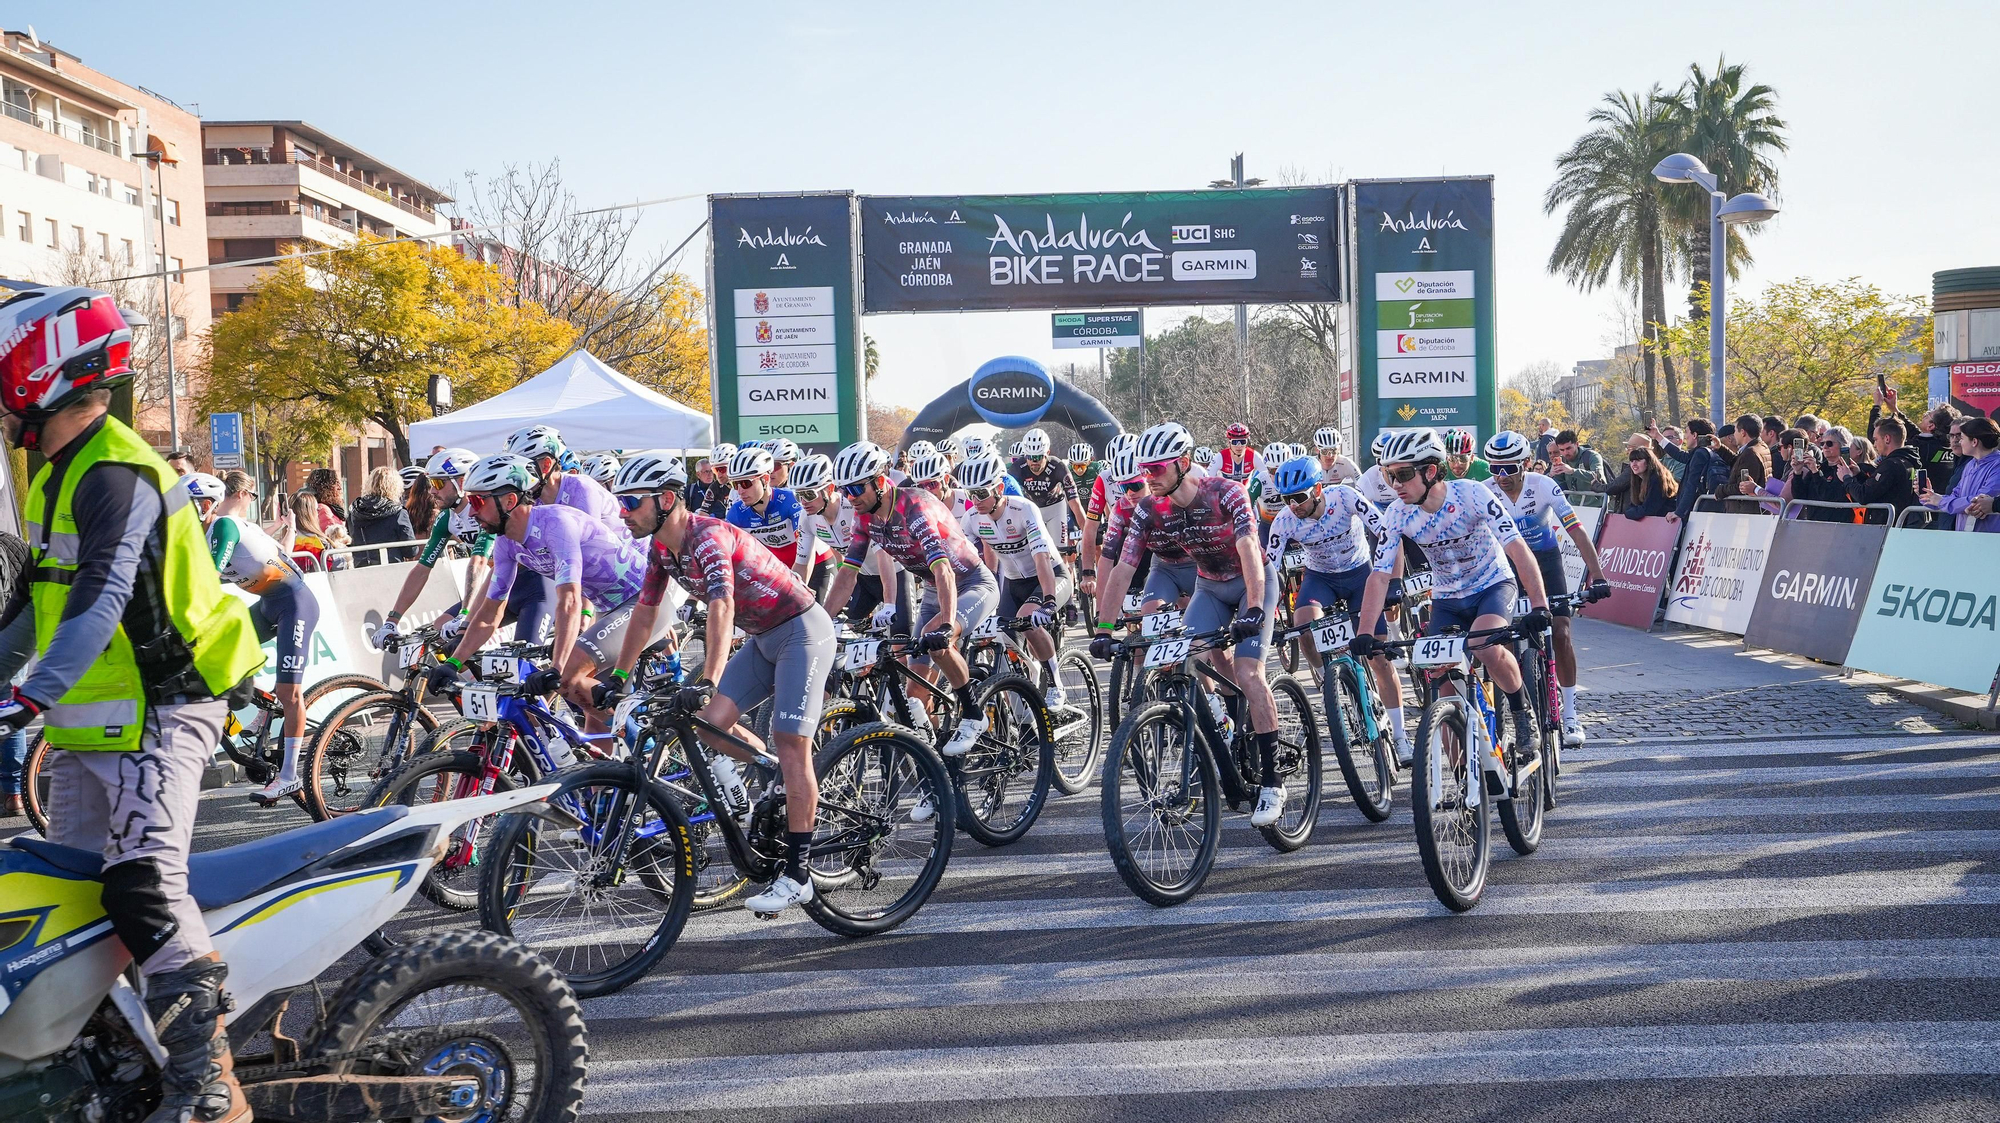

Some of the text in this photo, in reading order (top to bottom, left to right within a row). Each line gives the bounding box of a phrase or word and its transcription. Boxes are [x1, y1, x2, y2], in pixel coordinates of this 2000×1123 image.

[884, 211, 938, 225] Andalucía
[1379, 209, 1469, 233] Andalucía
[737, 225, 828, 249] Andalucía
[985, 210, 1163, 256] Andalucía
[1178, 228, 1236, 240] UCI SHC
[899, 241, 953, 254] GRANADA
[911, 255, 941, 271] JAÉN
[989, 253, 1165, 286] BIKE RACE
[1181, 259, 1248, 271] GARMIN
[900, 271, 953, 287] CÓRDOBA
[1417, 280, 1454, 289] Diputación
[1073, 326, 1119, 336] CÓRDOBA
[1418, 336, 1455, 345] Diputación
[1428, 343, 1456, 351] Córdoba
[778, 352, 818, 360] AYUNTAMIENTO
[1982, 346, 2000, 356] AYU
[778, 361, 785, 369] DE
[1388, 370, 1466, 385] GARMIN
[748, 387, 829, 402] GARMIN
[977, 386, 1046, 399] GARMIN
[912, 426, 944, 435] garmin.com
[1081, 421, 1112, 431] garmin.com
[218, 540, 235, 572] KOMETA
[425, 536, 448, 565] KOMETA
[1708, 546, 1764, 571] AYUNTAMIENTO
[1609, 549, 1666, 579] IMDECO
[1410, 573, 1433, 591] 11-2
[1700, 575, 1711, 597] DE
[1771, 569, 1859, 610] GARMIN
[538, 613, 552, 641] KTM
[1151, 614, 1171, 632] 2-2
[292, 619, 306, 648] KTM
[1321, 624, 1350, 647] 49-2
[577, 635, 607, 664] RAM
[851, 644, 870, 665] 2-1
[1151, 641, 1184, 662] 21-2
[1421, 639, 1455, 660] 49-1
[282, 655, 304, 670] SLP
[491, 656, 510, 674] 5-2
[1548, 672, 1560, 718] MANITOU
[471, 693, 489, 716] 5-1
[1040, 706, 1054, 743] MAXXIS
[853, 731, 896, 746] MAXXIS
[678, 825, 693, 877] MAXXIS
[6, 942, 63, 974] Husqvarna
